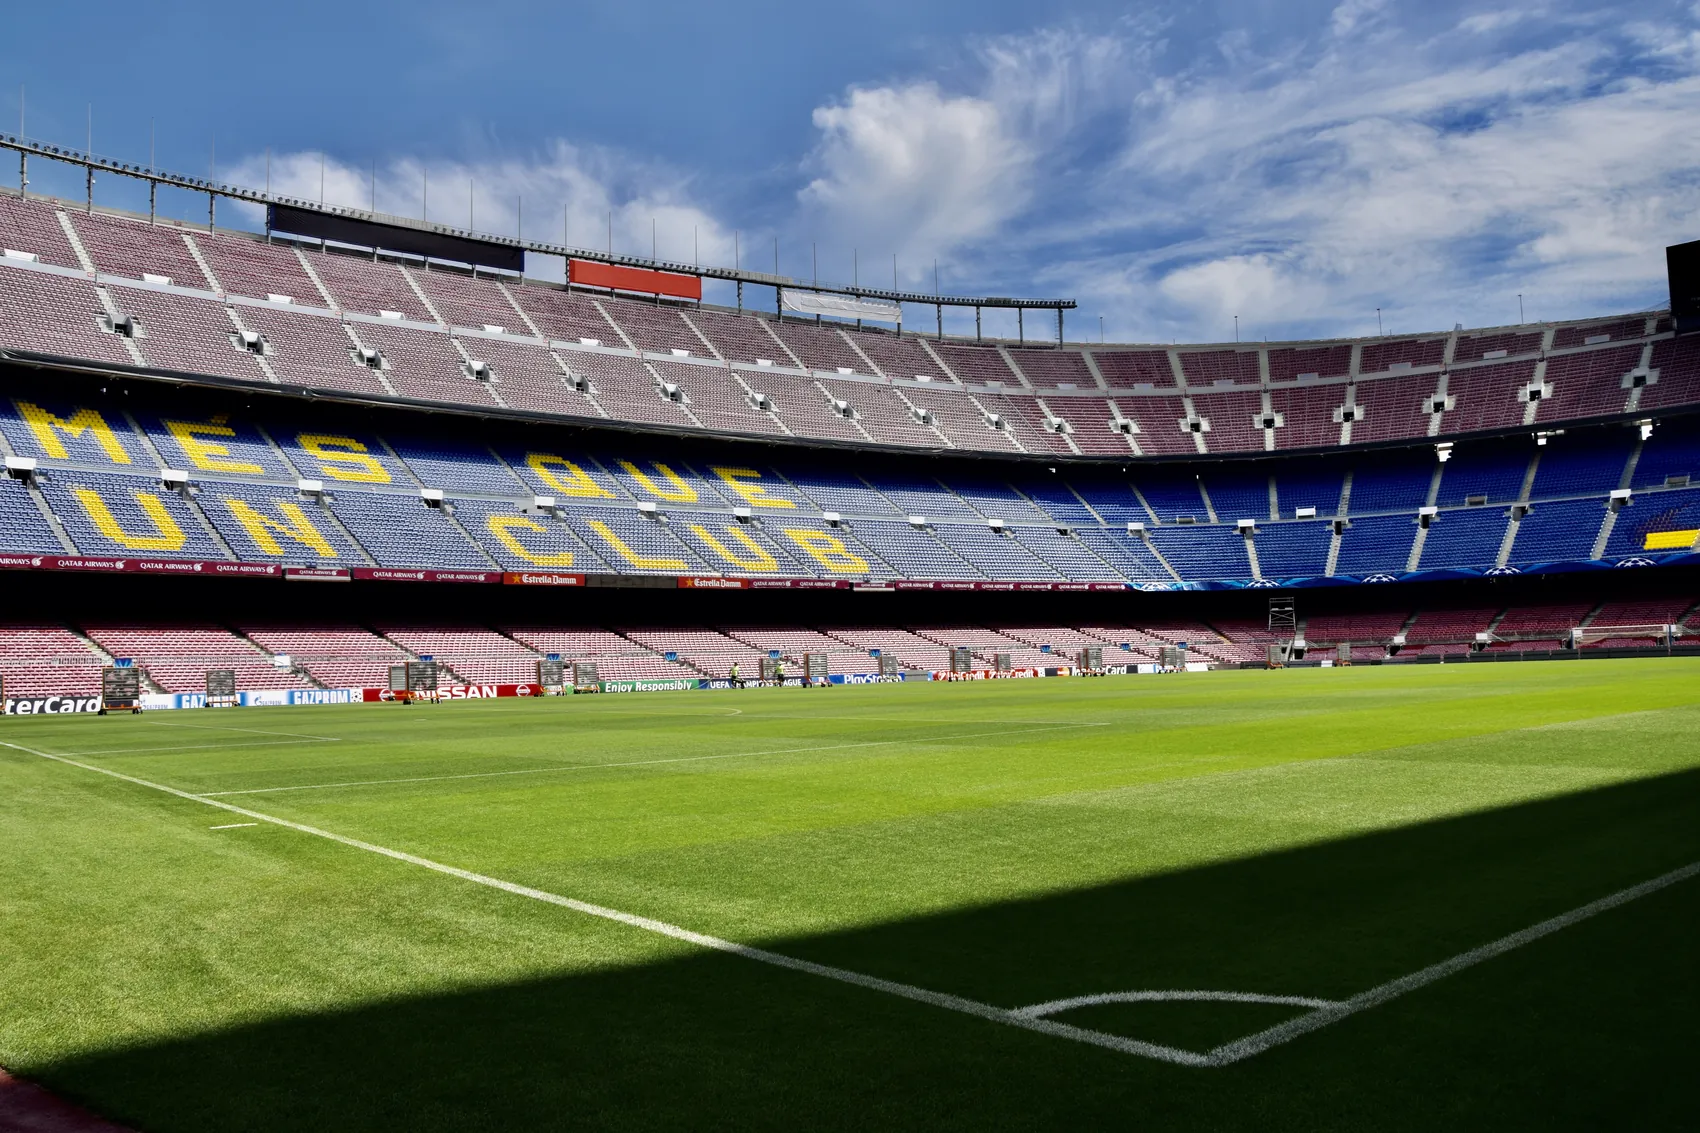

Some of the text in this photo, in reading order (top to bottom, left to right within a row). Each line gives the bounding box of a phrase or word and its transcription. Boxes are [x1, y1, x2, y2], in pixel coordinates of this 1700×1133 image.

[17, 400, 797, 509] MÉS QUE
[75, 489, 871, 573] UN CLUB
[522, 574, 577, 584] Estrella Damm
[694, 578, 742, 588] Estrella Damm
[605, 680, 692, 693] Enjoy Responsibly
[294, 690, 348, 704] GAZPROM
[0, 696, 102, 715] terCard
